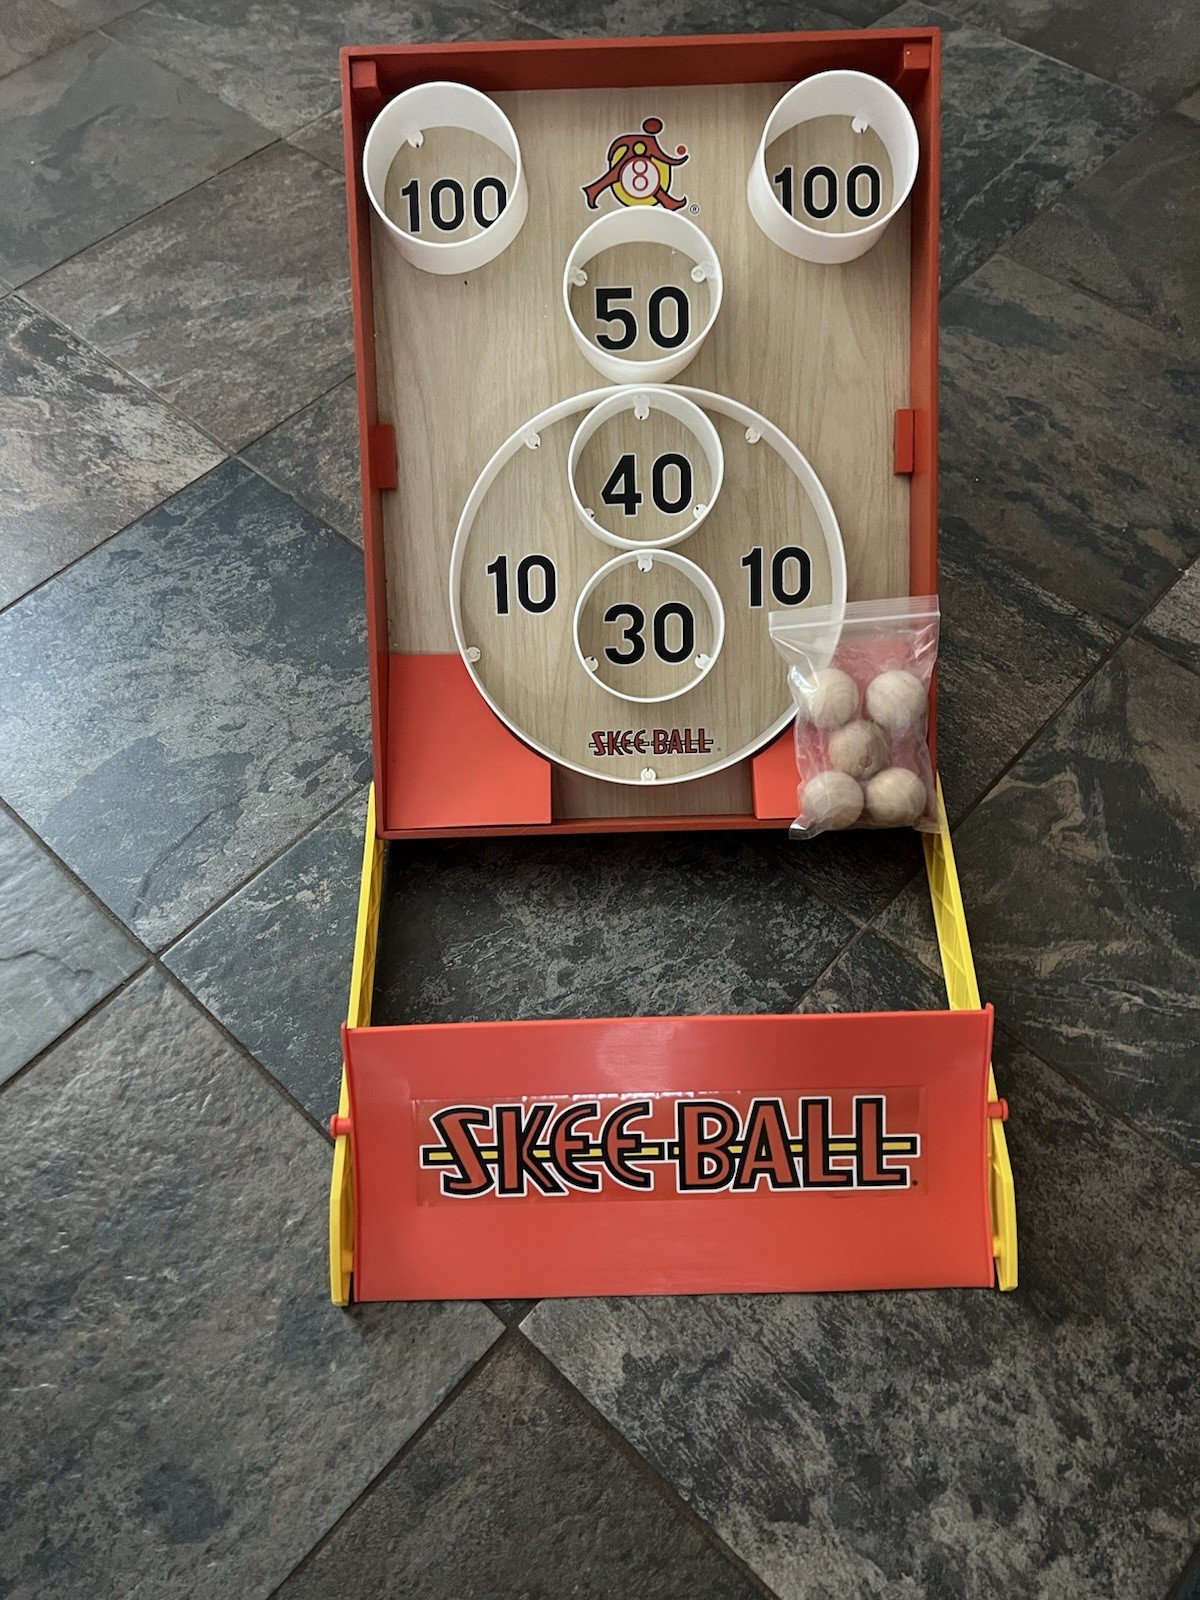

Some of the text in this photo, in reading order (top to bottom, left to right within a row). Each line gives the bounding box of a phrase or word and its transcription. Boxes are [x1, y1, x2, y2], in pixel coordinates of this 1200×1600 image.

[401, 177, 507, 232] 100
[774, 165, 881, 219] 100
[595, 286, 690, 350] 50
[601, 453, 692, 516] 40
[487, 554, 556, 615] 10
[741, 547, 812, 608] 10
[604, 602, 694, 665] 30
